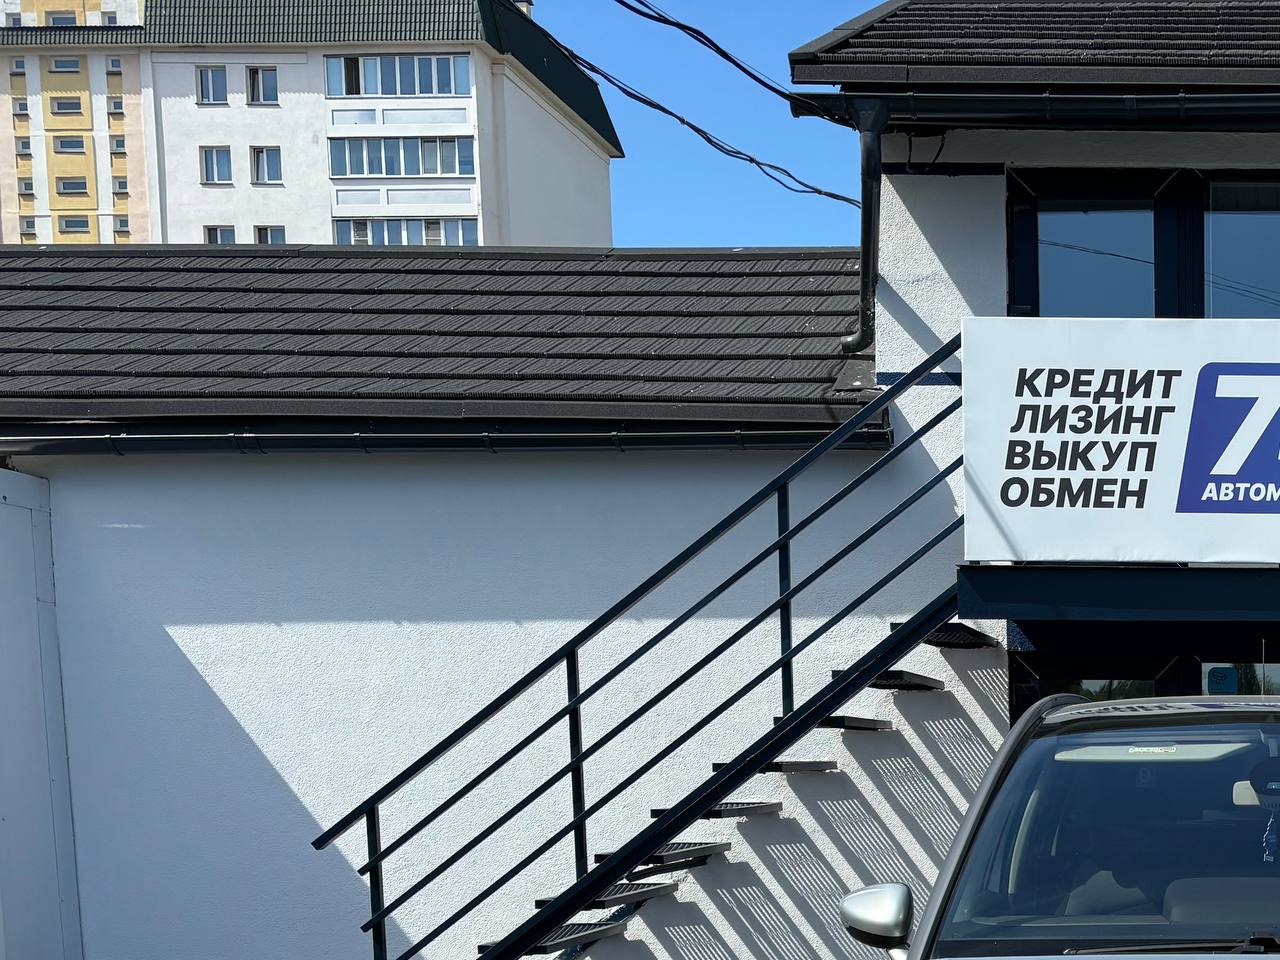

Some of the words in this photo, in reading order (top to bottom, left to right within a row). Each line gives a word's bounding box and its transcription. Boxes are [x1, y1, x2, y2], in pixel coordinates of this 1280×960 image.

[1014, 368, 1182, 404] КРЕДИТ
[1010, 404, 1176, 435] ЛИЗИНГ
[1004, 440, 1157, 471] ВЫКУП
[1000, 476, 1147, 509] ОБМЕН
